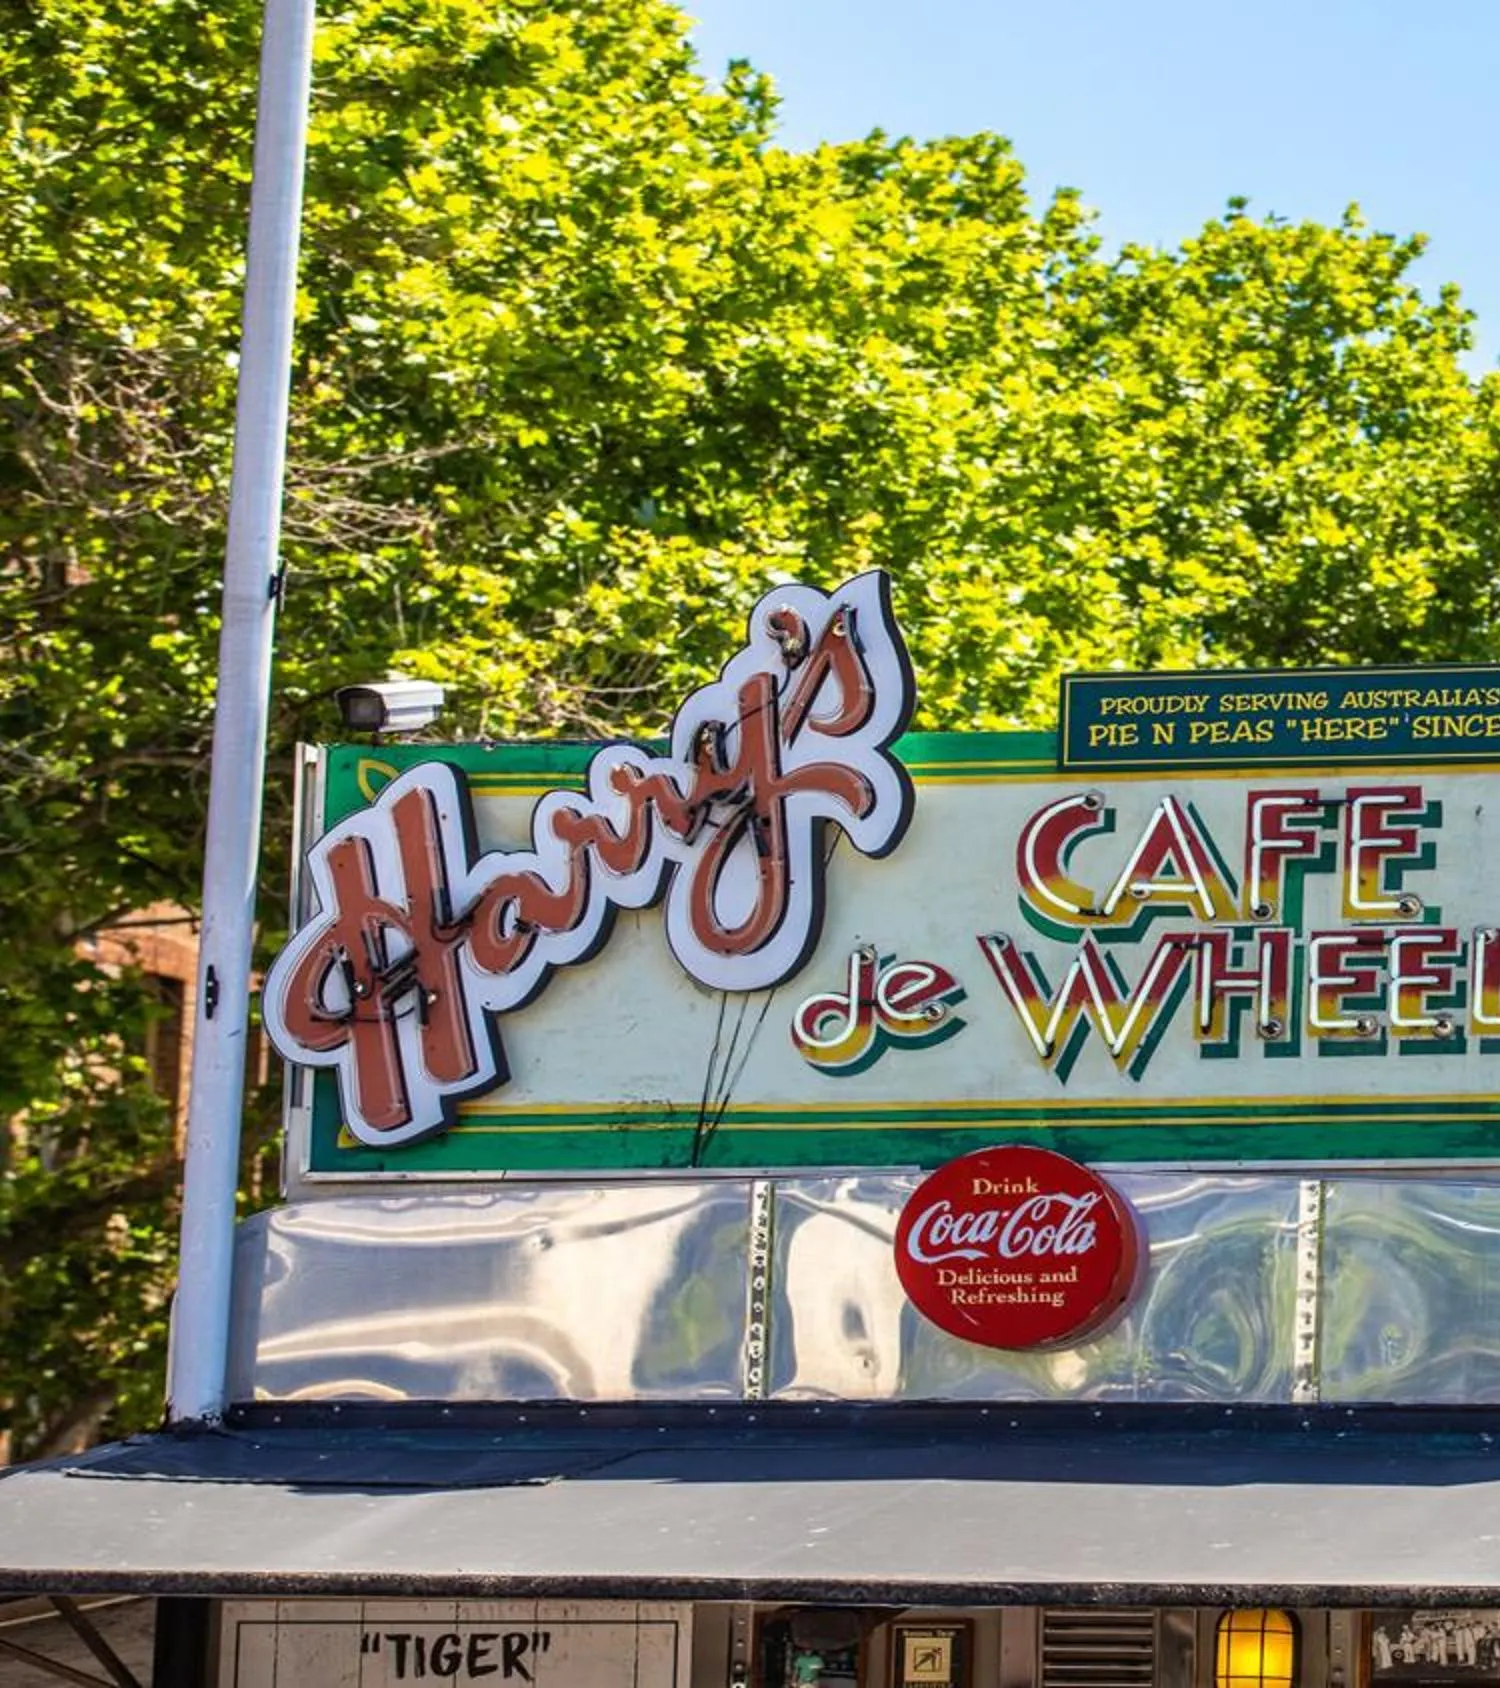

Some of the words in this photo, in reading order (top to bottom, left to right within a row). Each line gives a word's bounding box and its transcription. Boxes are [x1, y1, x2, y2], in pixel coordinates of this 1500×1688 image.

[1099, 694, 1210, 717] PROUDLY
[1219, 691, 1329, 714] SERVING
[1339, 687, 1500, 710] AUSTRALIA'S
[1088, 722, 1140, 748] PIE
[1150, 723, 1176, 746] N
[1188, 719, 1275, 745] PEAS
[1285, 715, 1400, 742] "HERE"
[280, 596, 884, 1134] Harry's
[1016, 786, 1444, 944] CAFE
[790, 943, 969, 1078] de
[972, 1176, 1040, 1197] Drink
[938, 1268, 1033, 1287] Delicious
[1039, 1265, 1079, 1284] and
[951, 1286, 1066, 1308] Refreshing
[360, 1632, 551, 1680] "TIGER"
